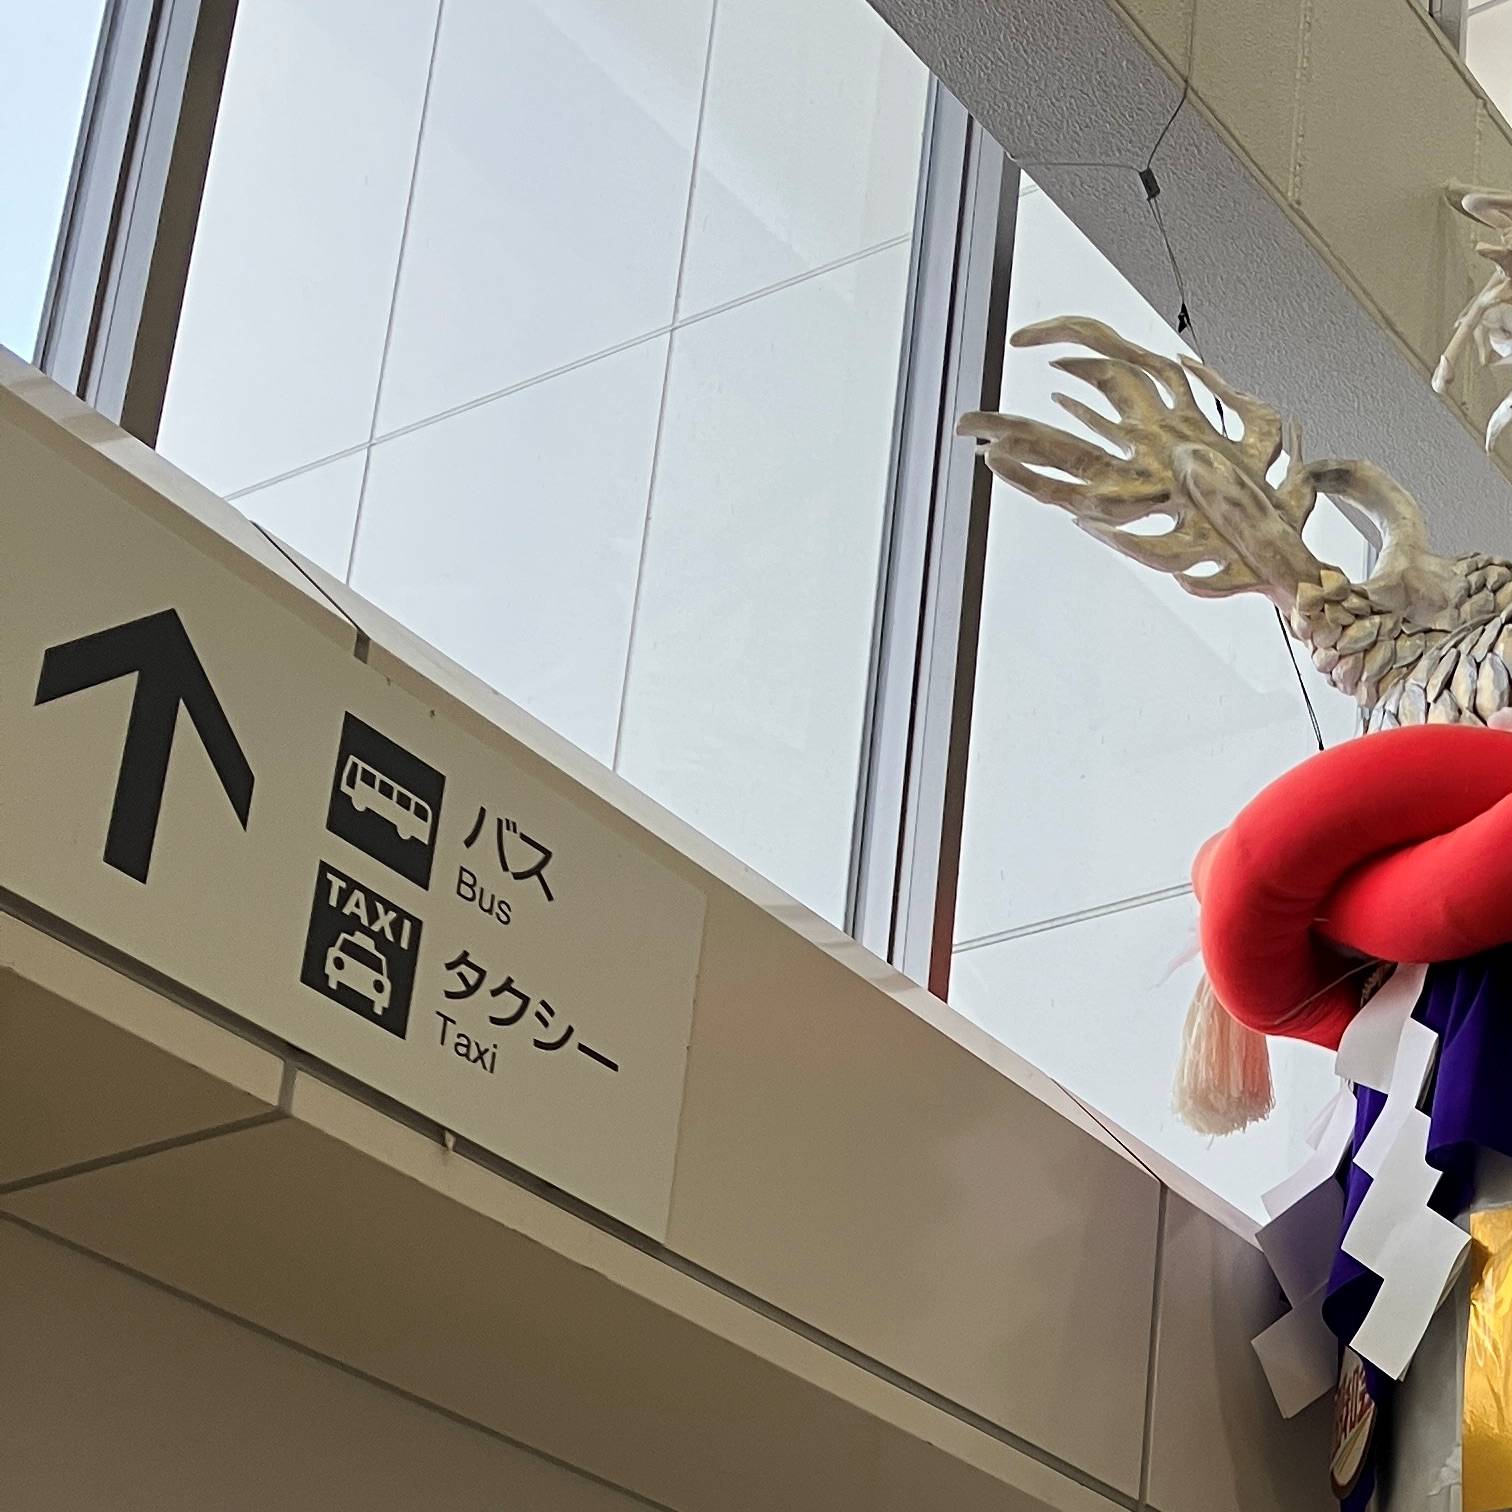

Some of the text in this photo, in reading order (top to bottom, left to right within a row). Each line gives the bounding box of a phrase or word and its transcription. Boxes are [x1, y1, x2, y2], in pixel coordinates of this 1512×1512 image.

[463, 806, 554, 902] バス
[325, 872, 414, 951] TAXI
[456, 865, 513, 926] Bus
[434, 1010, 501, 1075] Taxi
[443, 950, 620, 1072] タクシー
